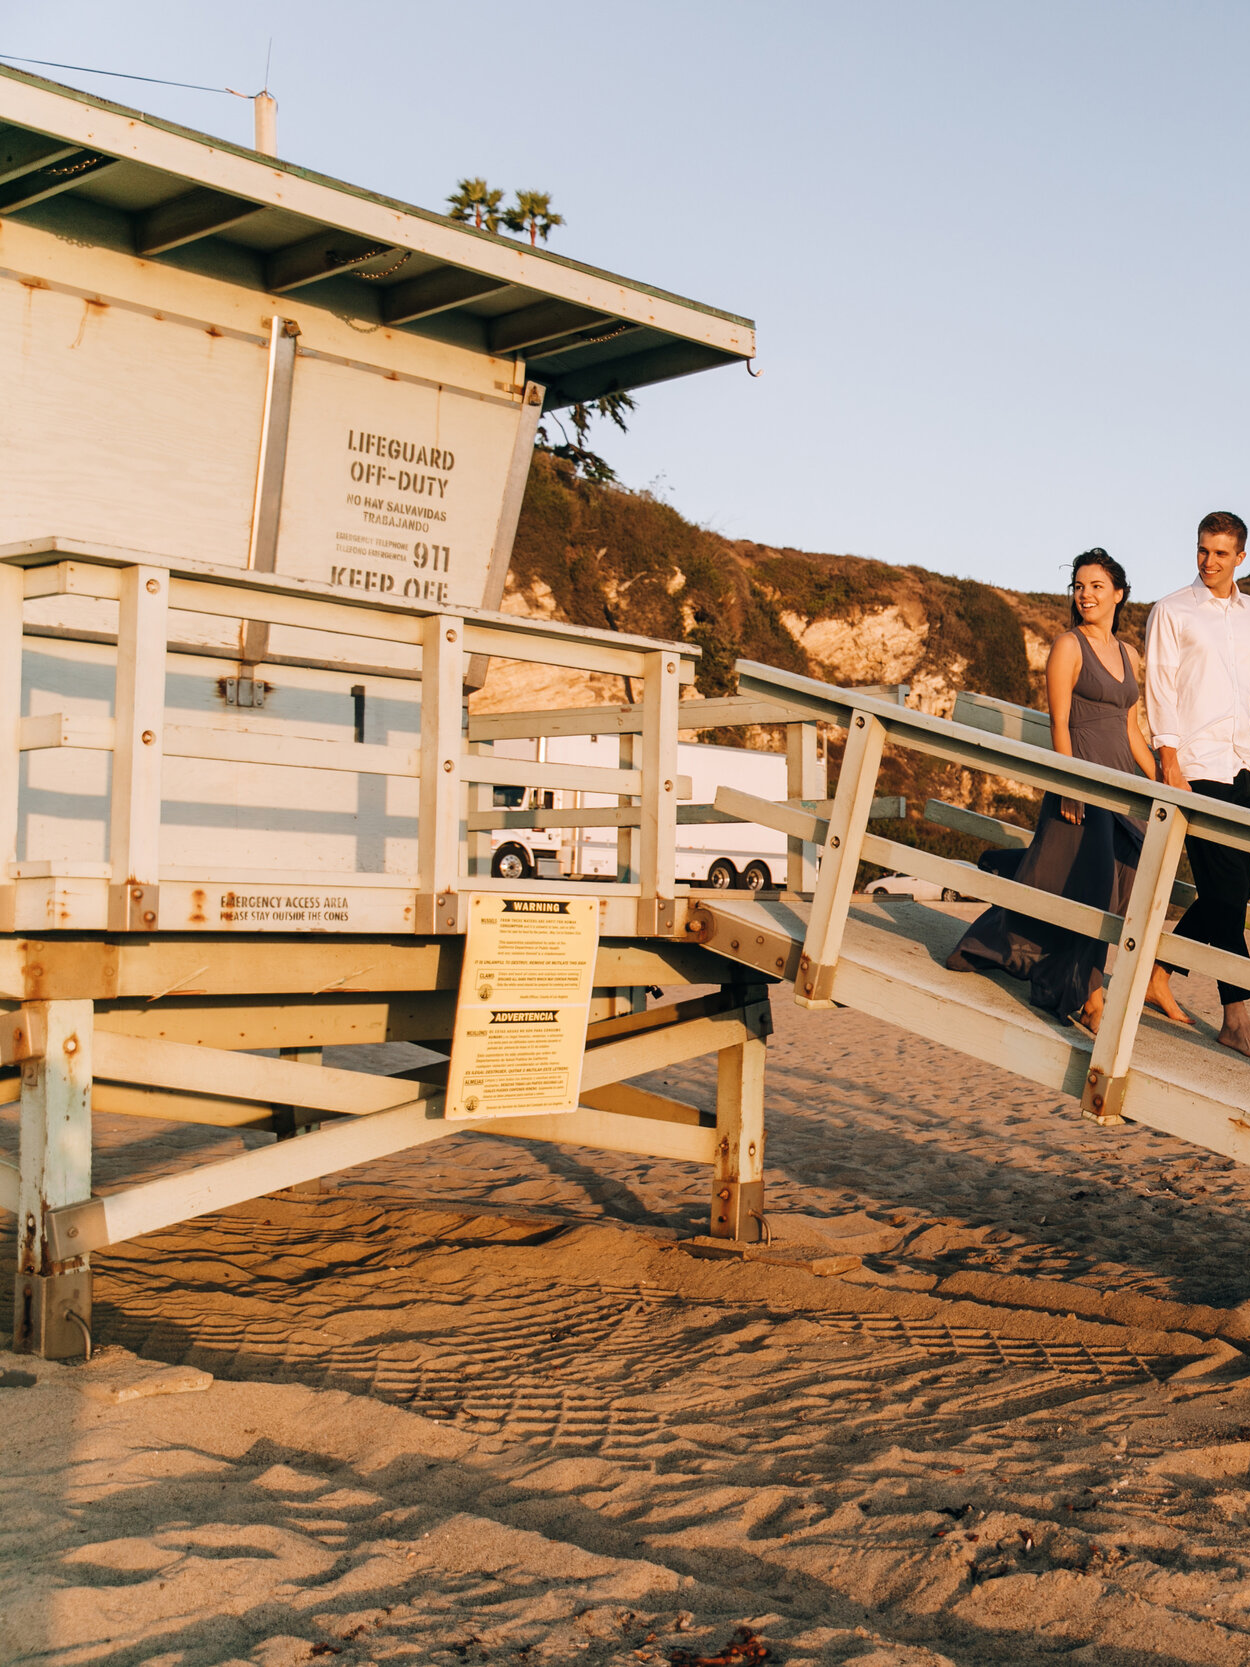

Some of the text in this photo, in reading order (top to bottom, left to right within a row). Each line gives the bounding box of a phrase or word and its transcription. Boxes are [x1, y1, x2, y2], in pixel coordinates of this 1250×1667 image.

[348, 429, 455, 471] LIFEGUARD
[350, 461, 448, 498] OFF-DUTY
[346, 493, 447, 522] NO HAY SALVAVIDAS
[363, 511, 430, 533] TRABAJANDO
[335, 531, 409, 551] EMERGENCY TELEPHONE
[413, 541, 450, 573] 911
[331, 565, 448, 602] KEEP OFF
[220, 896, 349, 908] EMERGENCY ACCESS AREA
[513, 901, 560, 912] WARNING
[220, 911, 349, 921] PLEASE STAY OUTSIDE THE CONES
[494, 1012, 554, 1022] ADVERTENCIA
